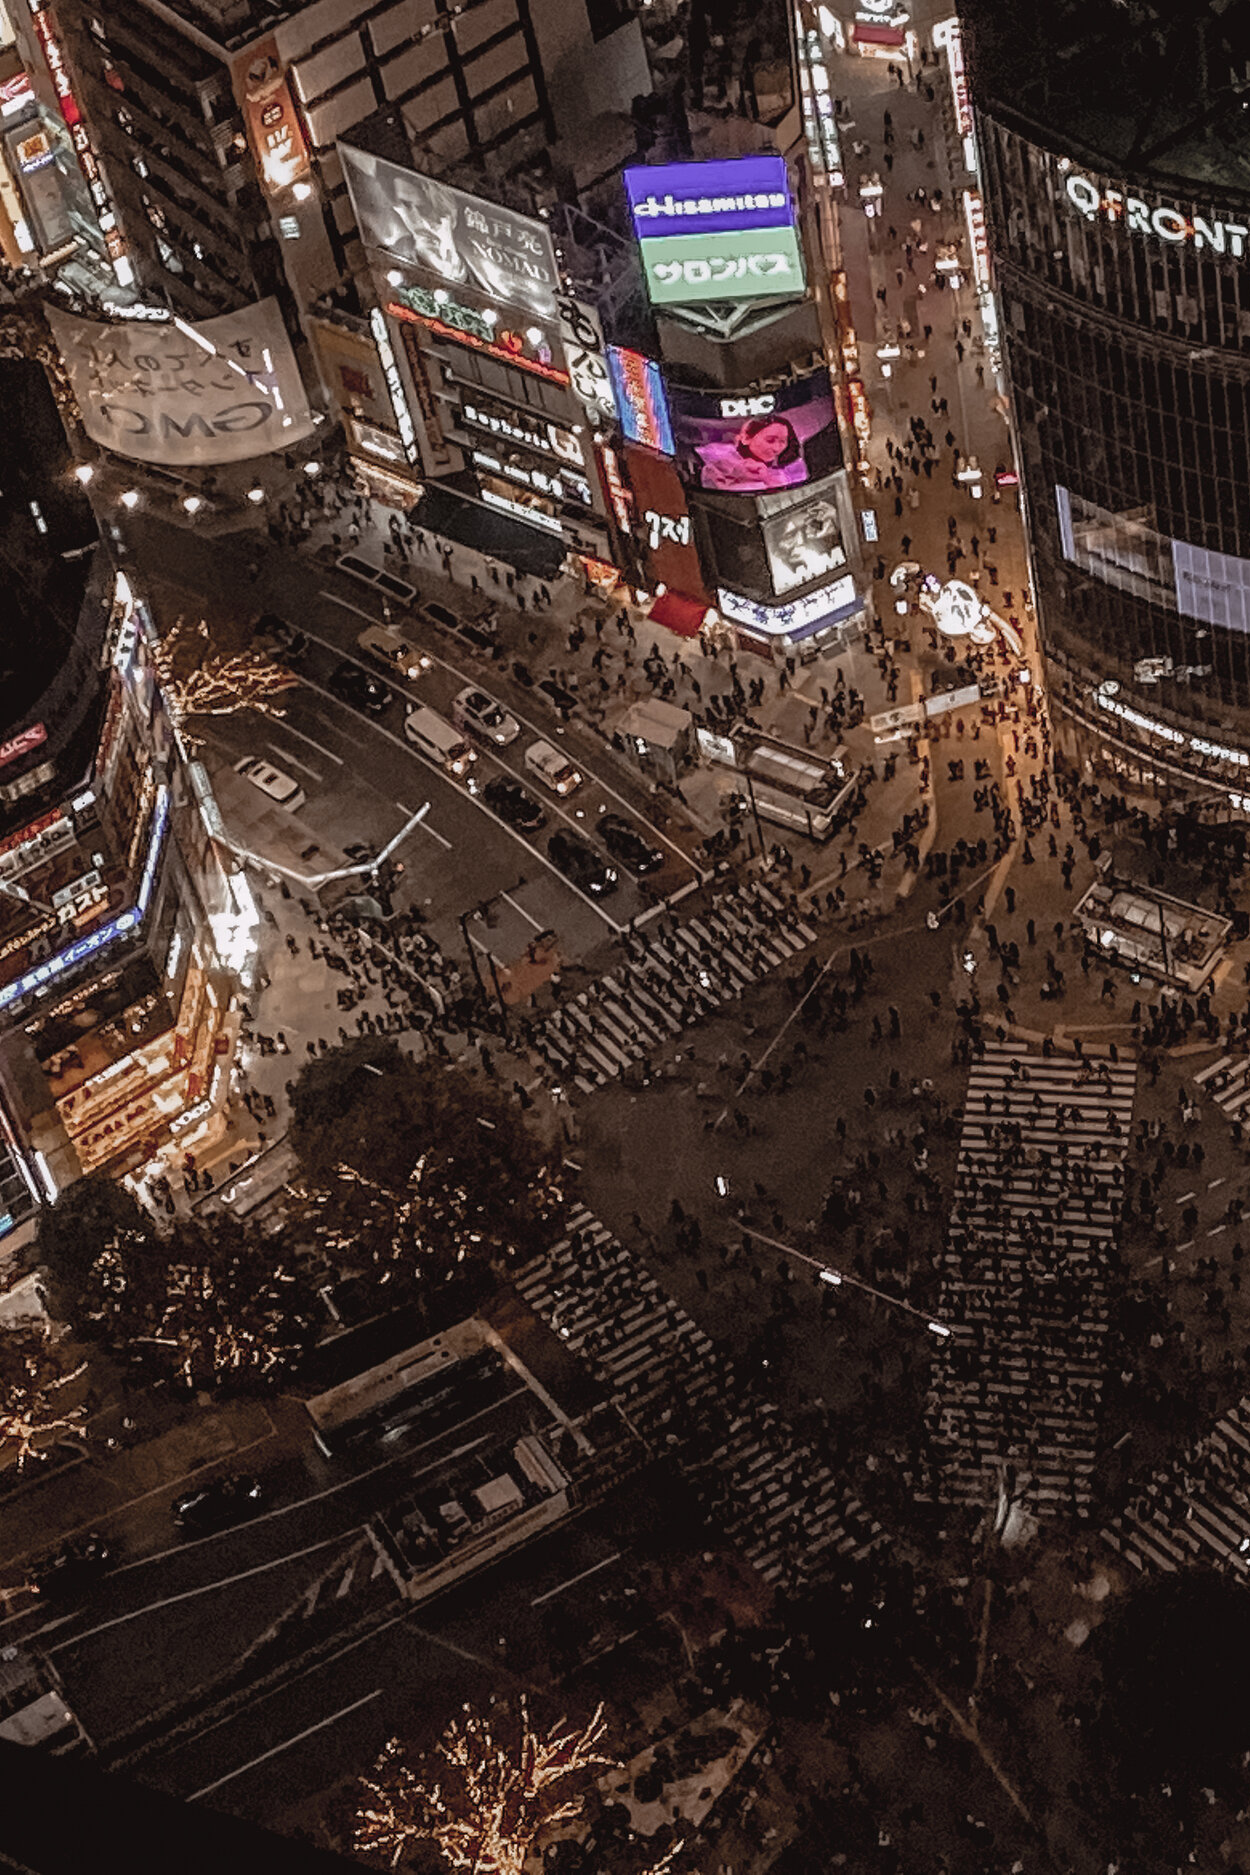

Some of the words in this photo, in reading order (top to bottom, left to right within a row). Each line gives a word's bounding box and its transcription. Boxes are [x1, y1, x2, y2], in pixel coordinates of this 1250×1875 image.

[1066, 175, 1249, 257] QFRONT
[653, 252, 792, 285] サロンパス
[720, 395, 776, 419] DHC
